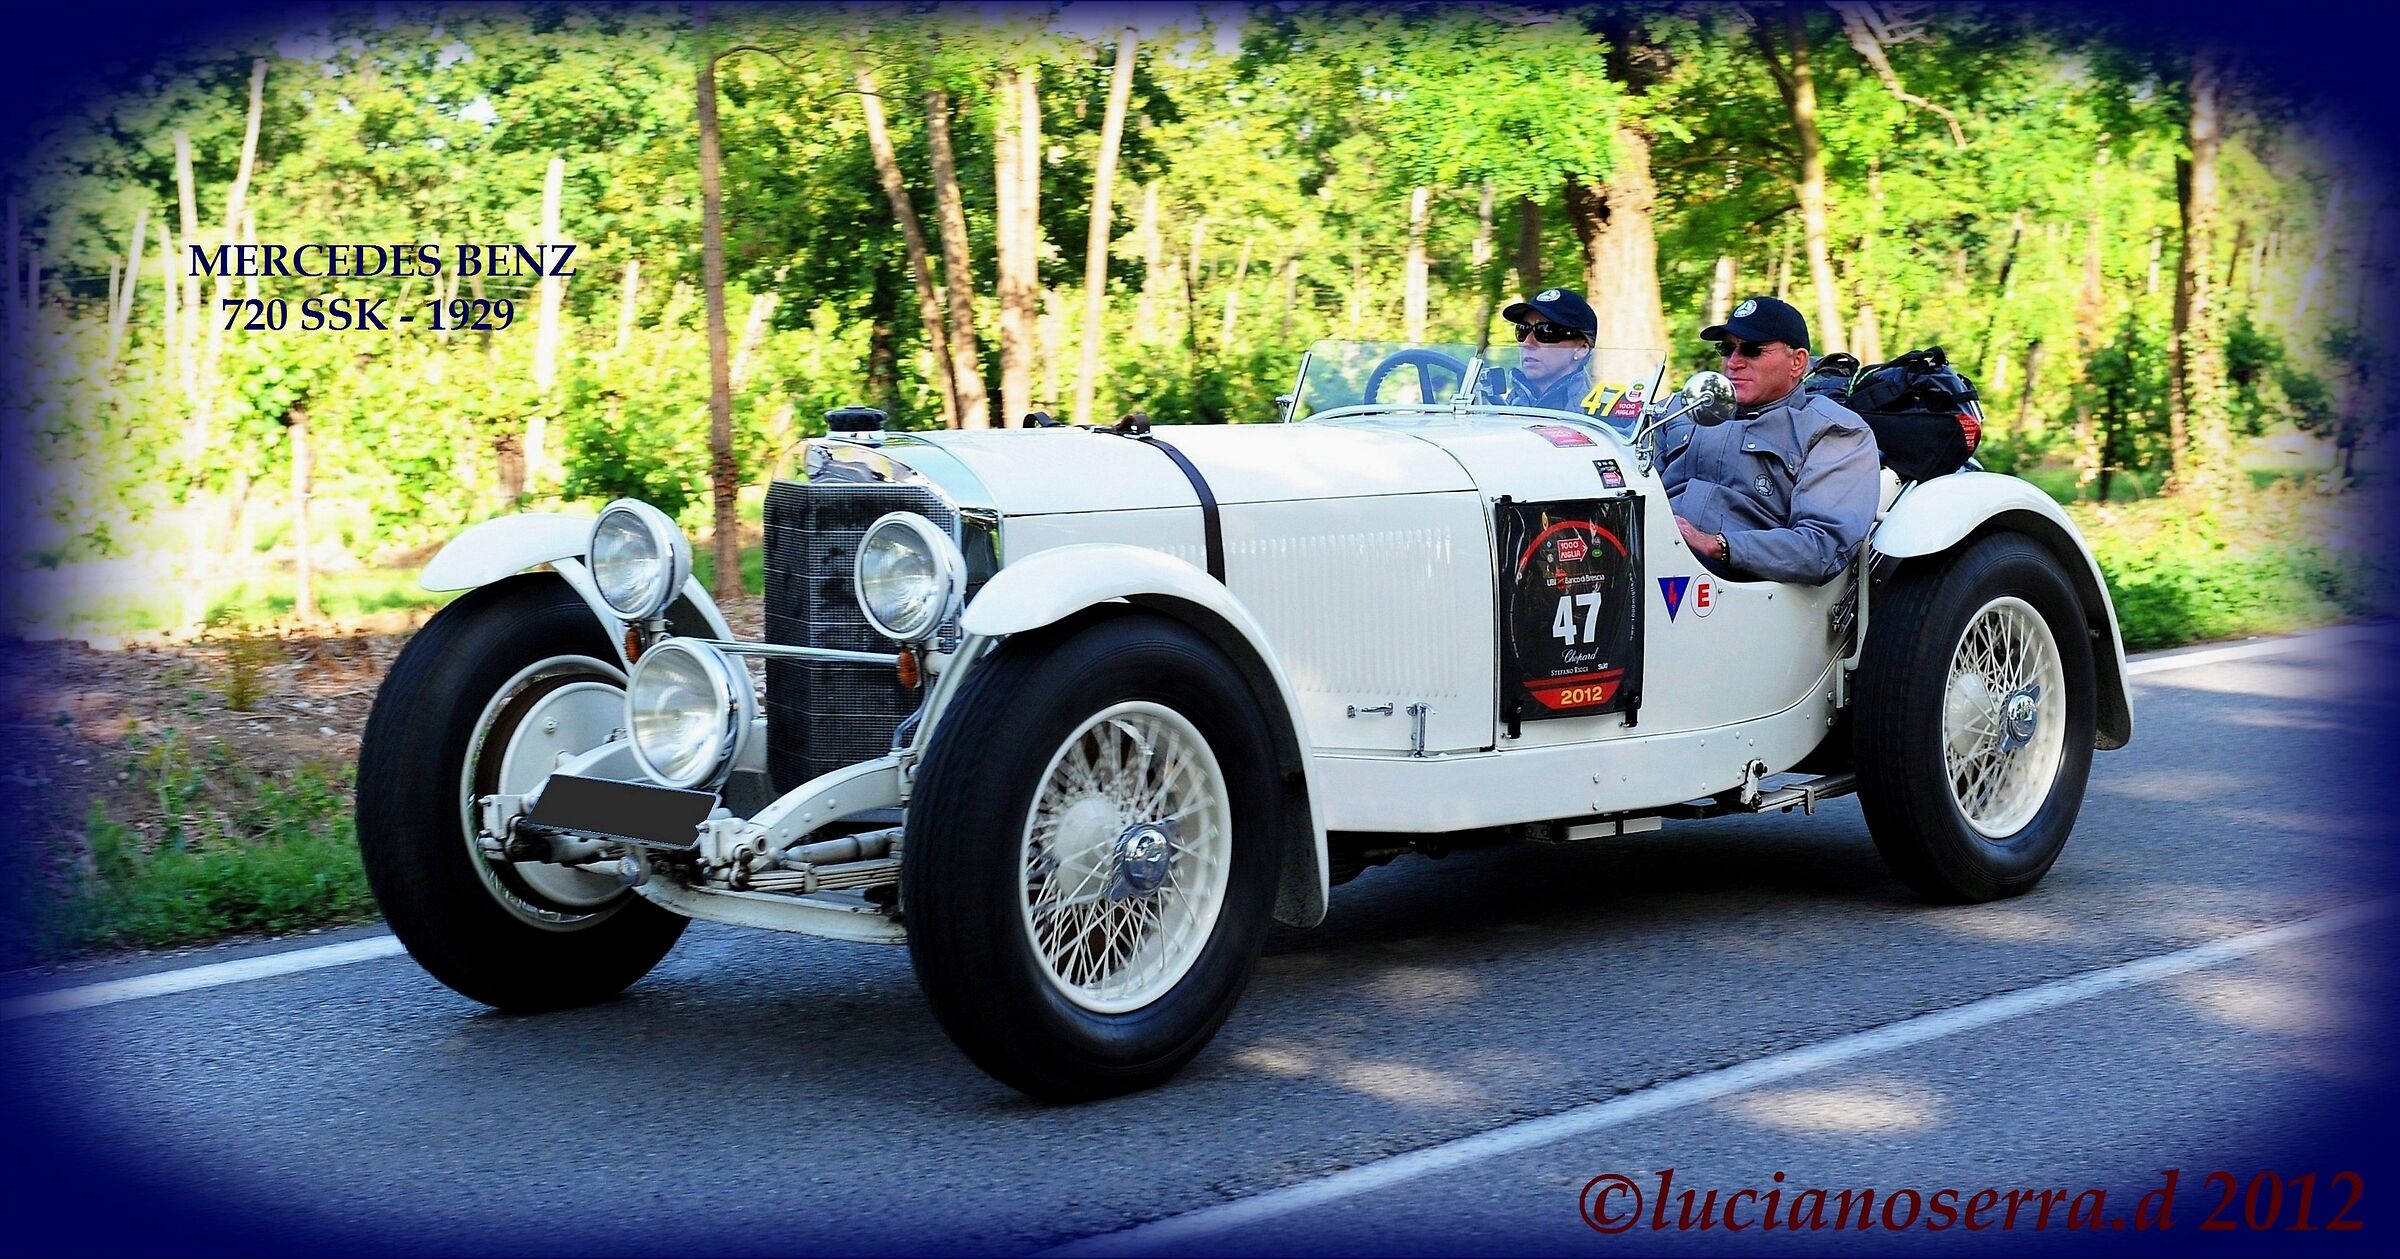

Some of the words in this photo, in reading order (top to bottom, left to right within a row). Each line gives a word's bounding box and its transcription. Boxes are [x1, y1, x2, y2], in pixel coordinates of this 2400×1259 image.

[1581, 383, 1627, 417] 47
[1560, 541, 1579, 550] 1000
[1560, 551, 1581, 559] MIGLIA
[1586, 574, 1605, 582] Brescia
[1697, 583, 1710, 608] E
[1552, 592, 1602, 646] 47
[1561, 647, 1600, 664] Chopard
[1560, 686, 1603, 705] 2012
